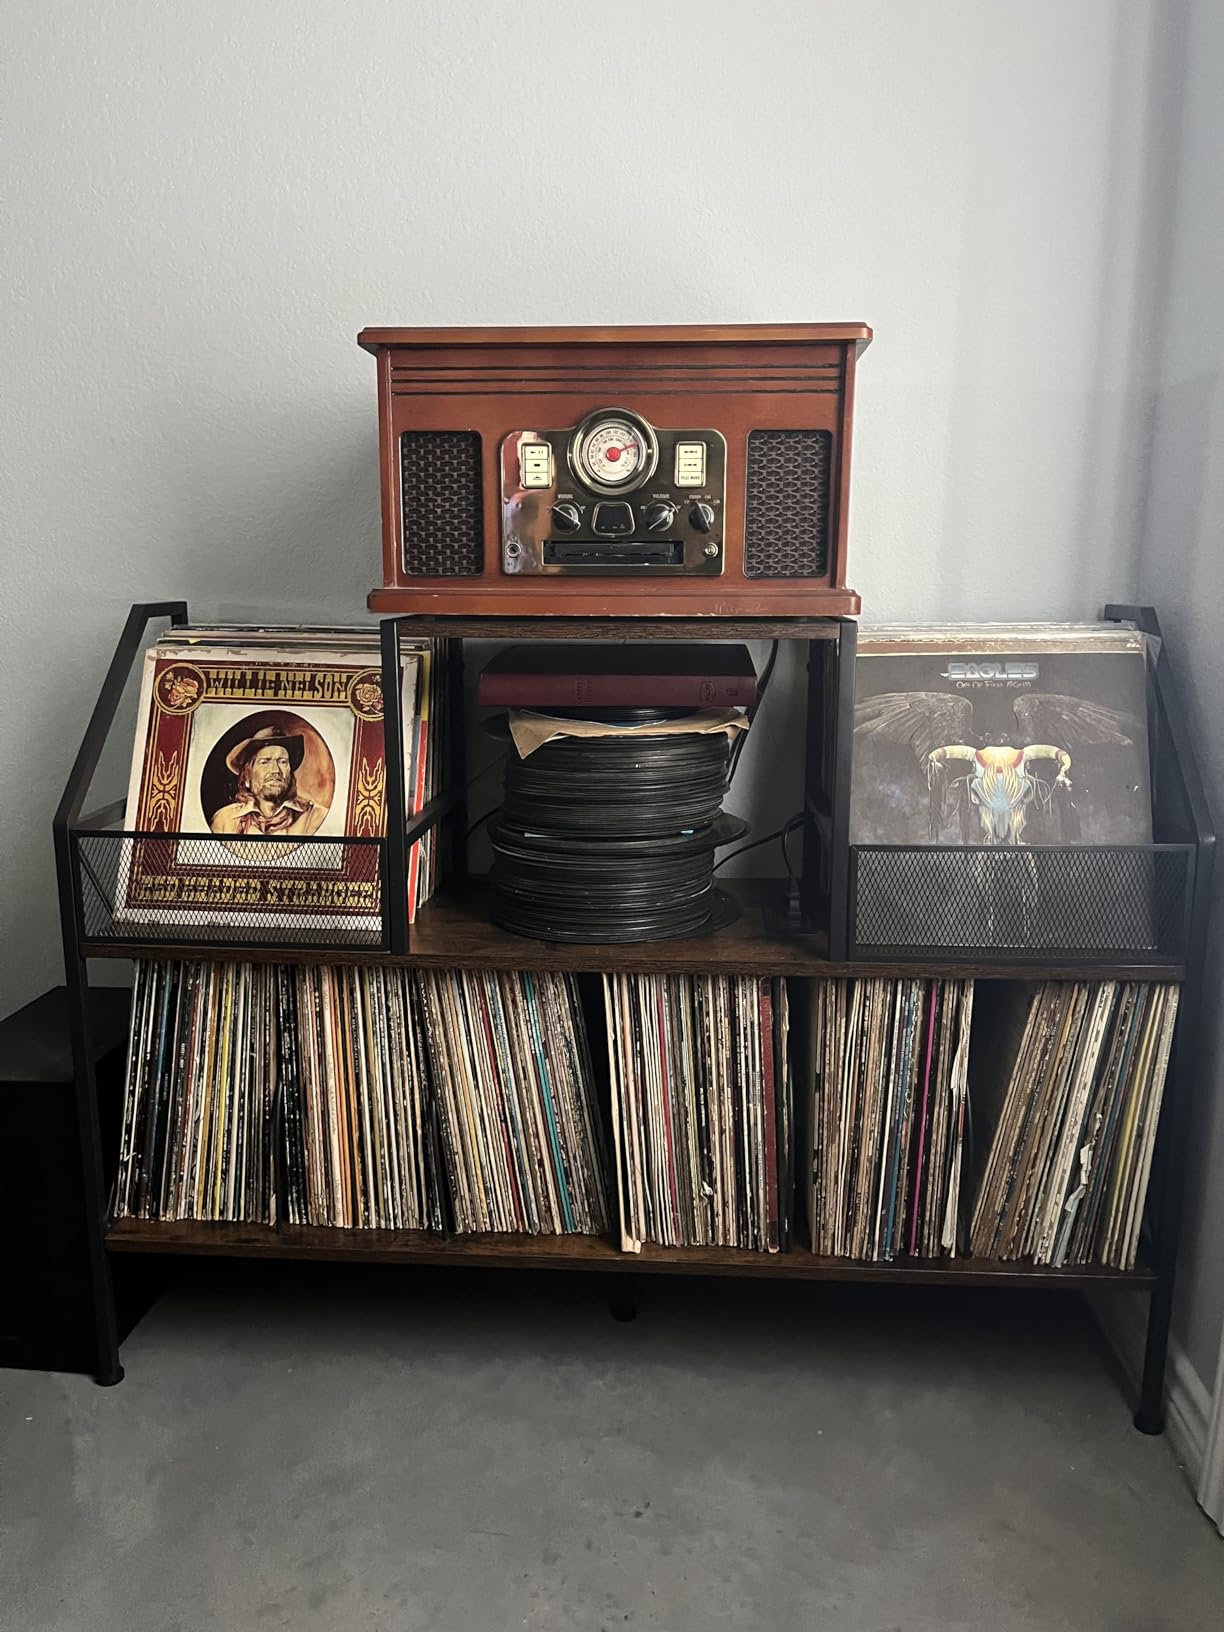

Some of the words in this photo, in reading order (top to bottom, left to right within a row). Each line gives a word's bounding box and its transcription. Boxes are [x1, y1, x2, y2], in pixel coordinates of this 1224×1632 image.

[948, 663, 1039, 680] EAGLES
[207, 670, 276, 698] WILLIE
[278, 671, 347, 700] NELSON
